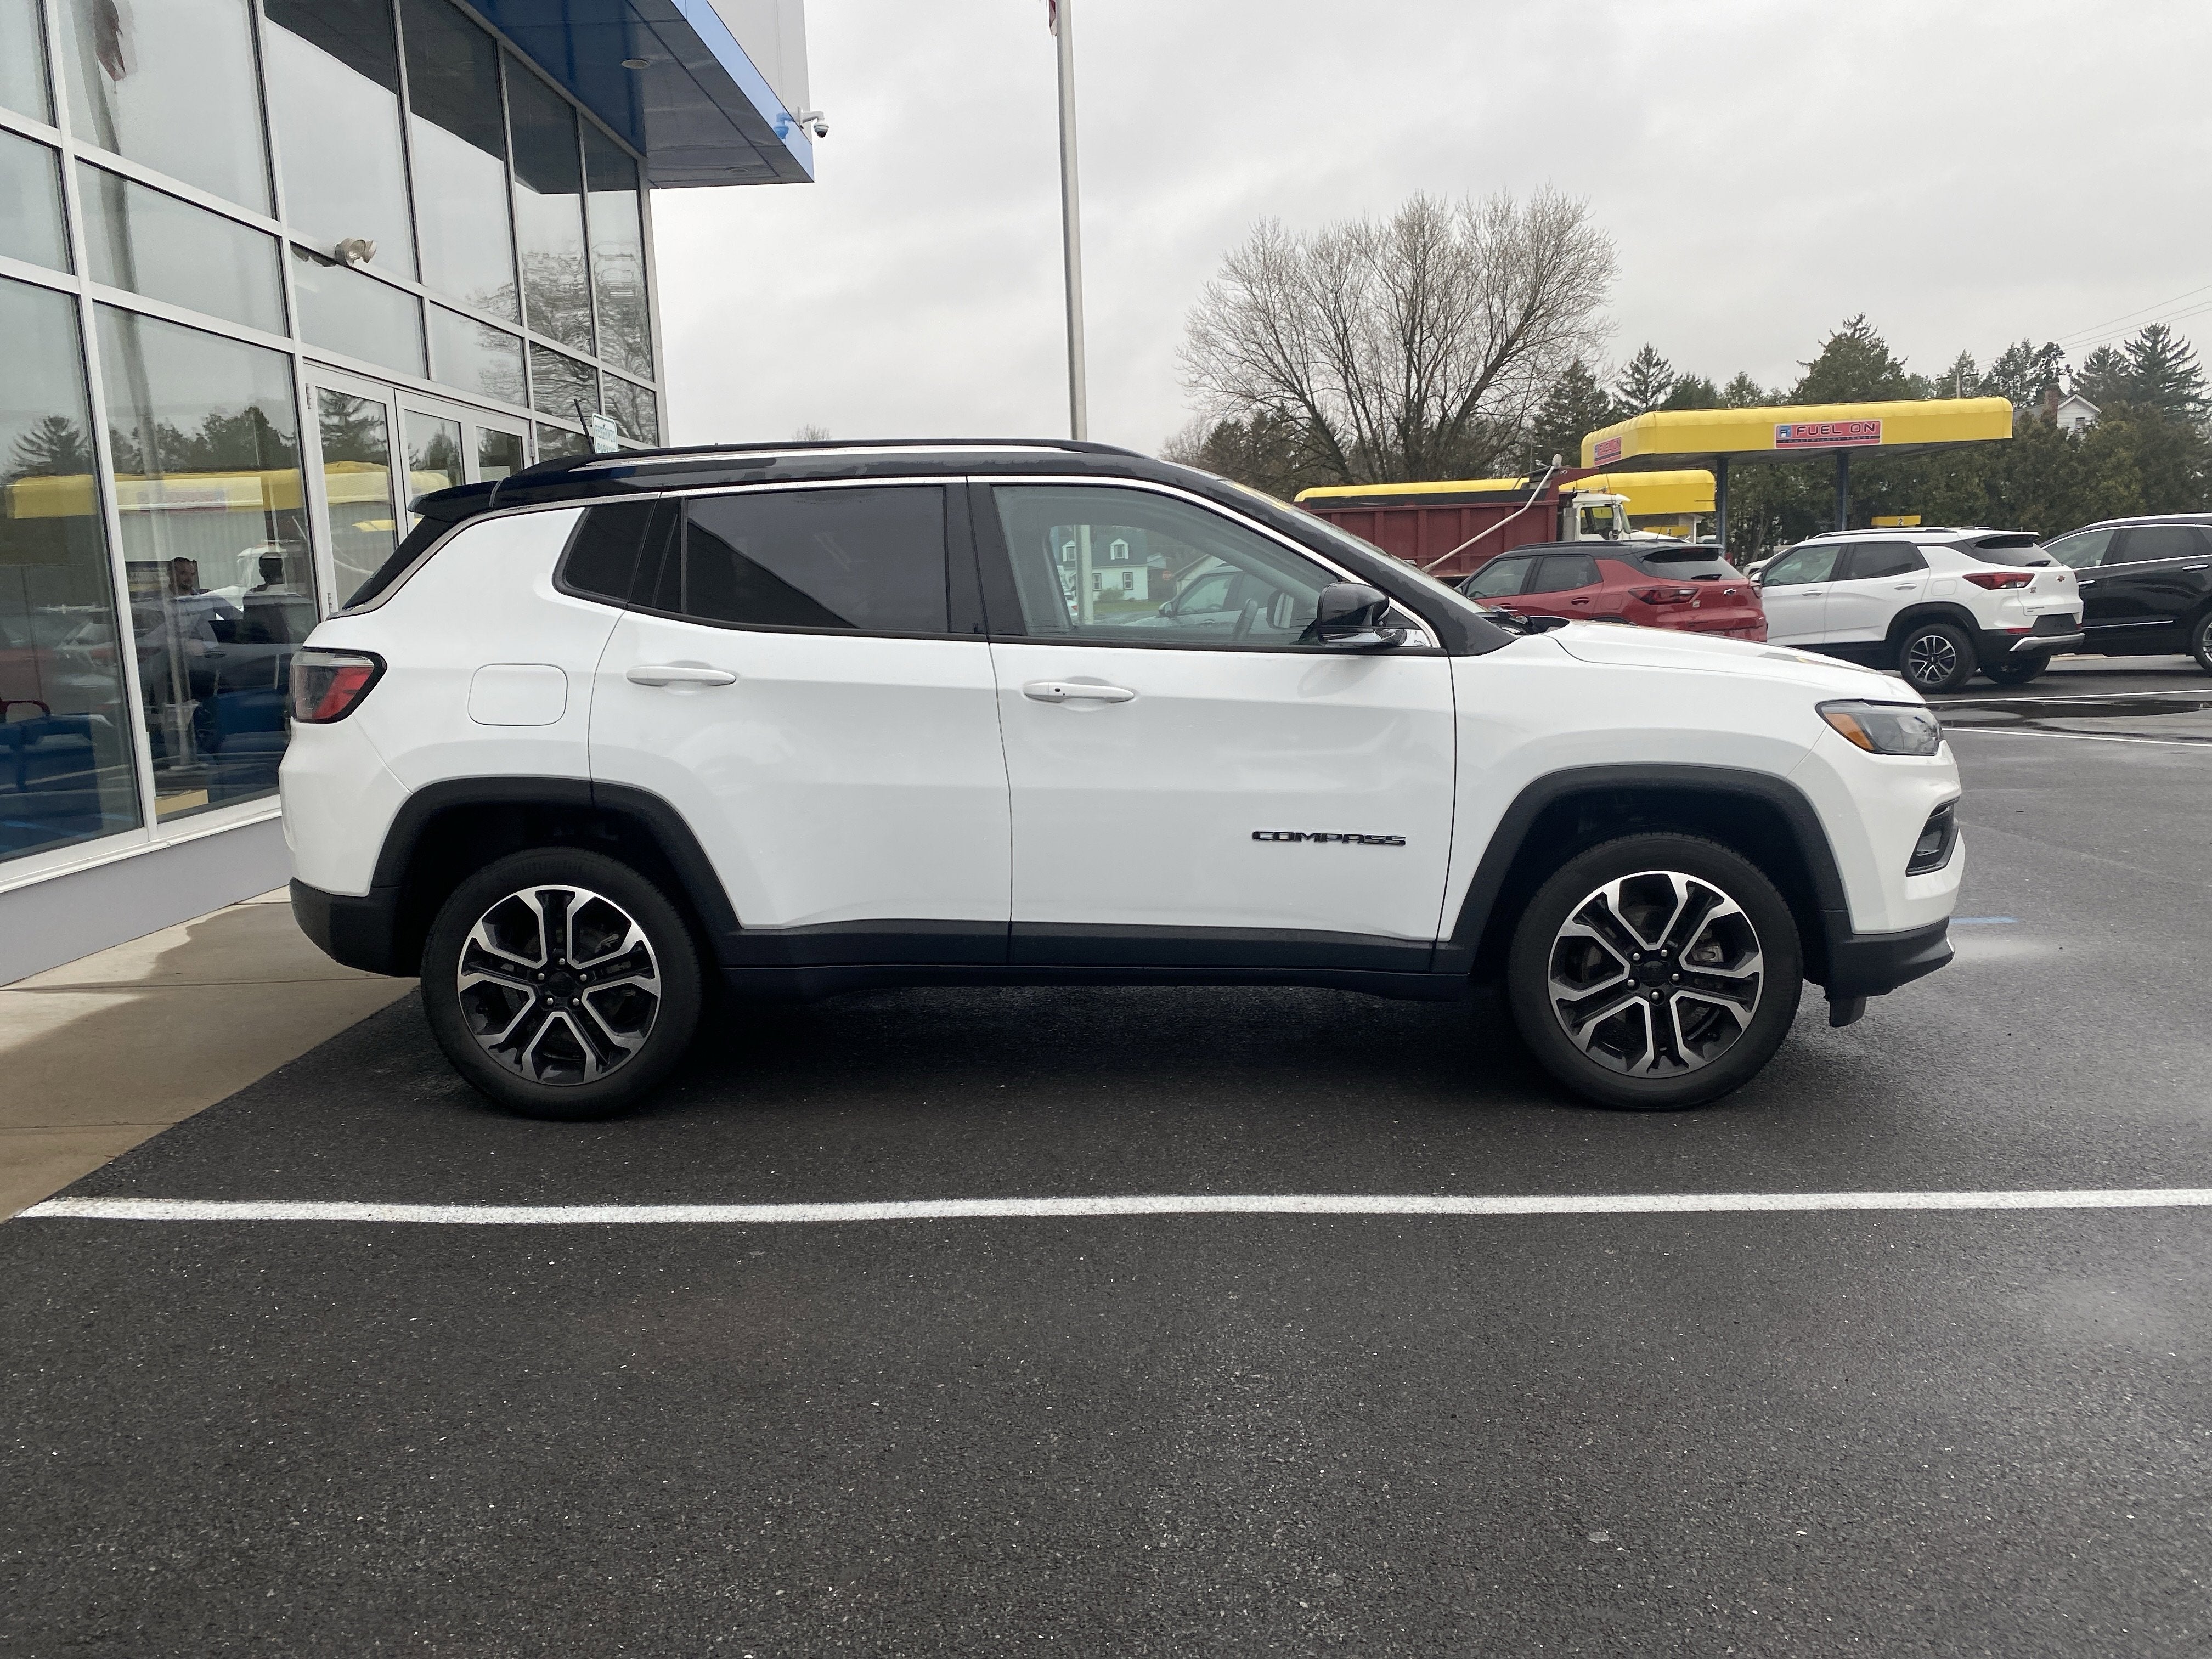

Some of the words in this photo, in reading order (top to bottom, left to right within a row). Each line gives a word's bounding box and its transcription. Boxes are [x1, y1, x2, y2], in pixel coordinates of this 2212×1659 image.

[1796, 424, 1842, 436] FUEL
[1850, 423, 1875, 433] ON
[1252, 831, 1406, 845] COMPASS
